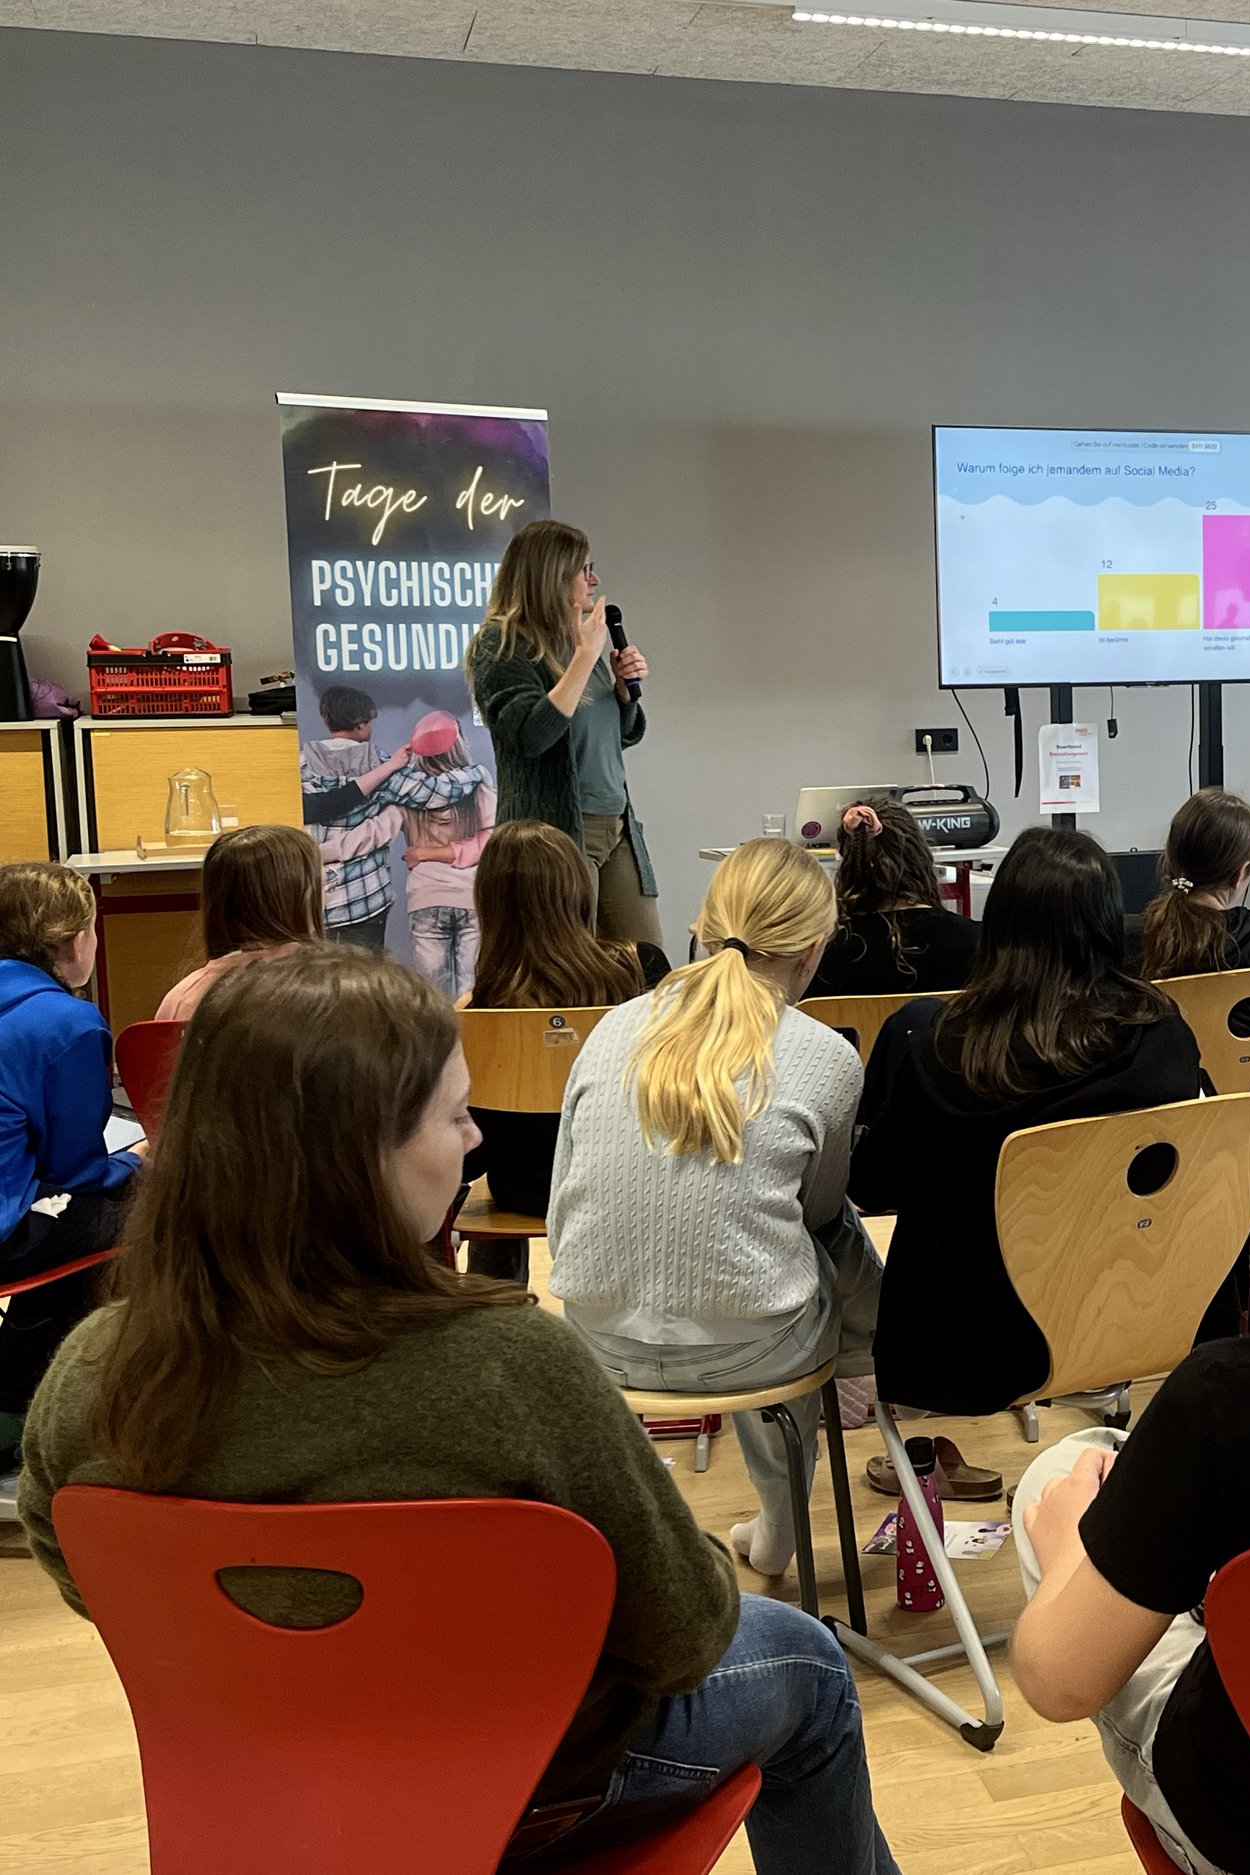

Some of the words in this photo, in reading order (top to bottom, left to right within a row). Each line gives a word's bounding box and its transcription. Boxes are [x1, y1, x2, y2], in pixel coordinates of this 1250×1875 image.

[956, 462, 996, 474] Warum
[999, 463, 1026, 477] folge
[1028, 463, 1043, 474] ich
[1046, 464, 1102, 477] jemandem
[1104, 465, 1121, 476] auf
[1123, 465, 1155, 477] Social
[1158, 466, 1196, 477] Media?
[308, 461, 428, 546] Tage
[455, 465, 525, 531] der
[1205, 500, 1217, 511] 25
[1101, 559, 1113, 570] 12
[311, 560, 502, 607] PSYCHISCH
[991, 597, 999, 607] 4
[917, 817, 971, 833] W-KING
[553, 1017, 562, 1027] 6
